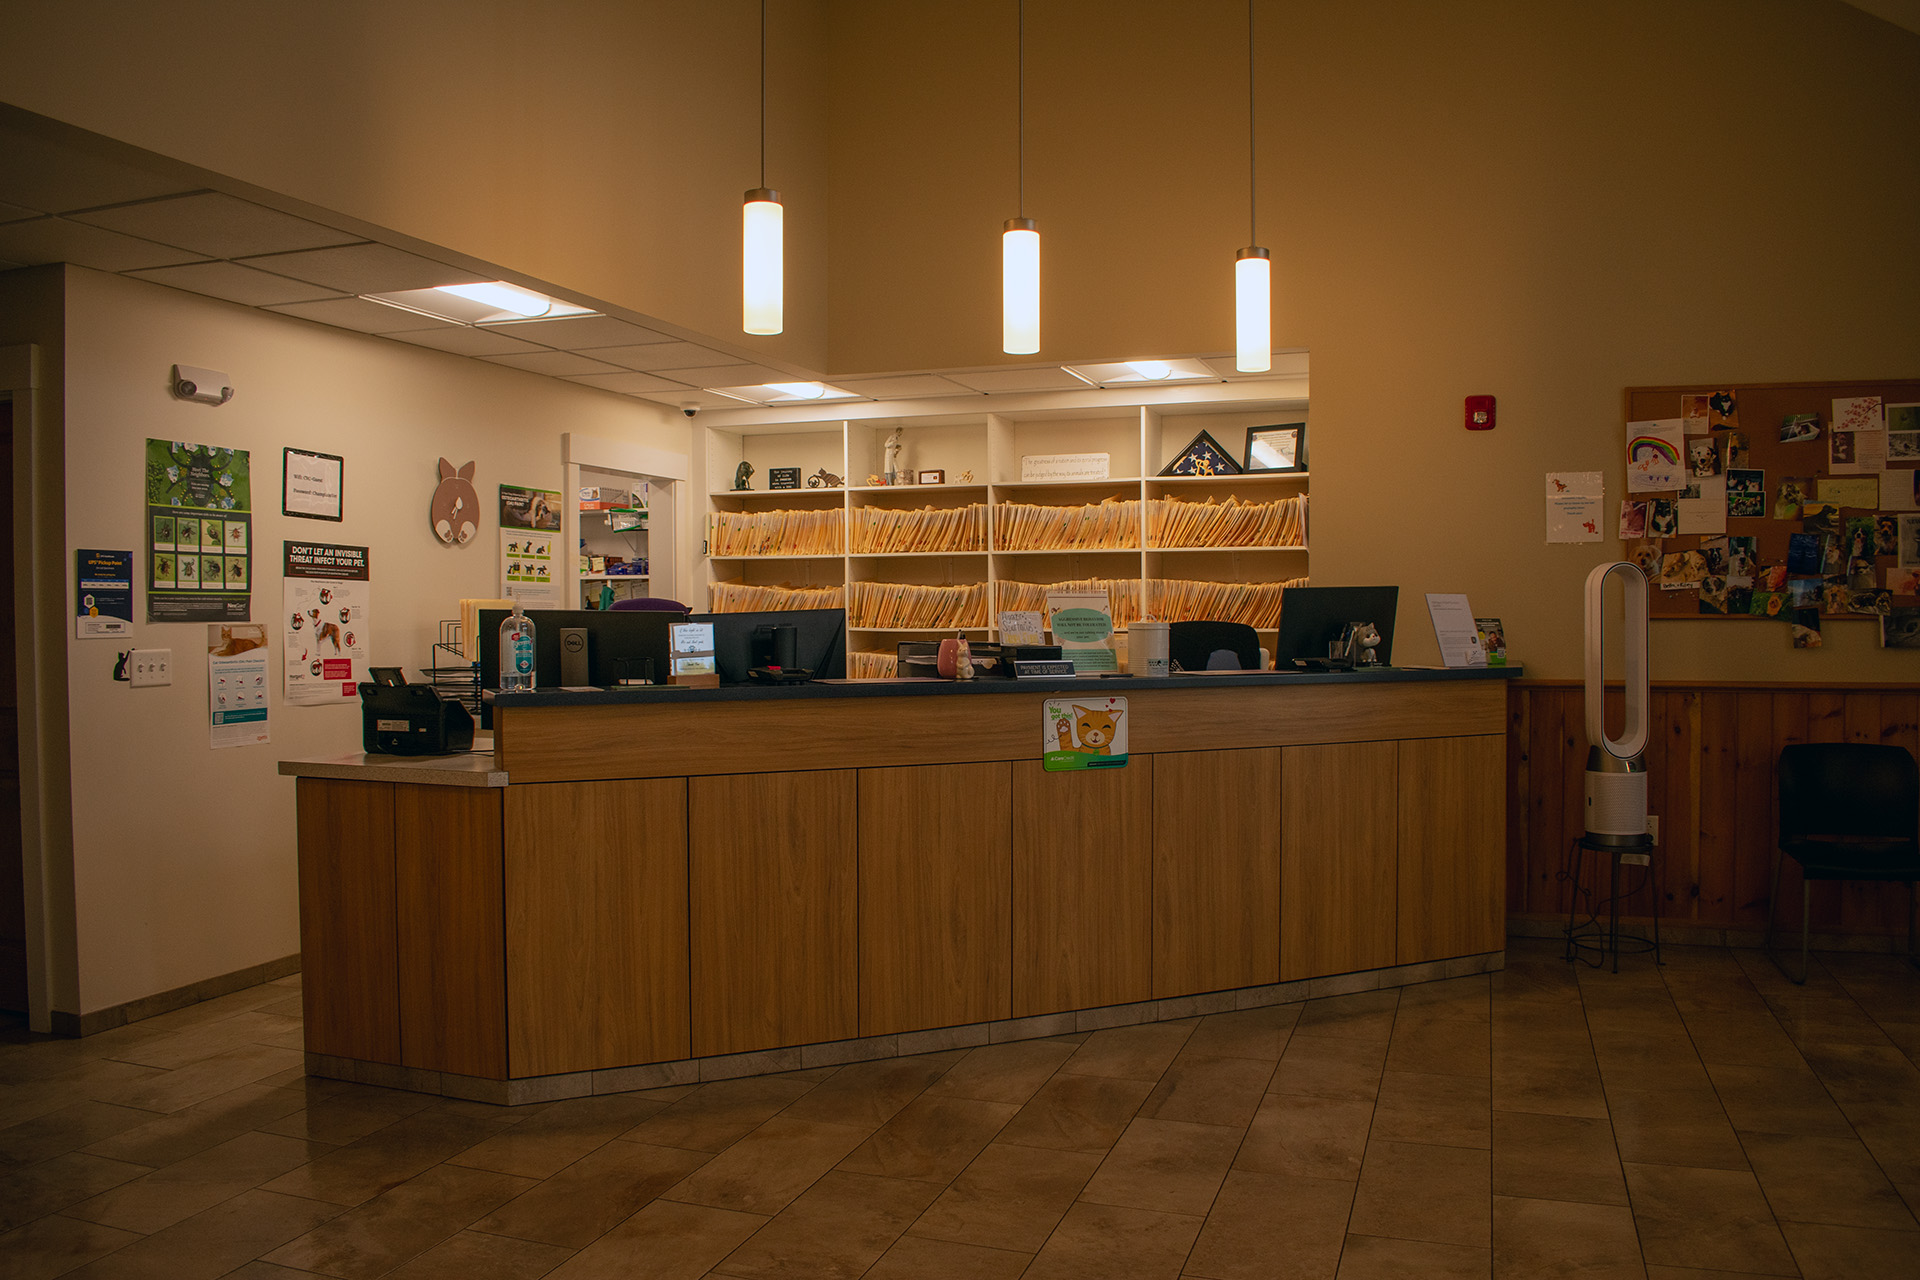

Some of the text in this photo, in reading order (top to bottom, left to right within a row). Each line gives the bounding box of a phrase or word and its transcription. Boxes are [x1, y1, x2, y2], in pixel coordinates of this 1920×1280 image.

[292, 546, 313, 555] DON'T
[335, 549, 362, 558] INVISIBLE
[290, 555, 313, 563] THREAT
[314, 556, 335, 565] INFECT
